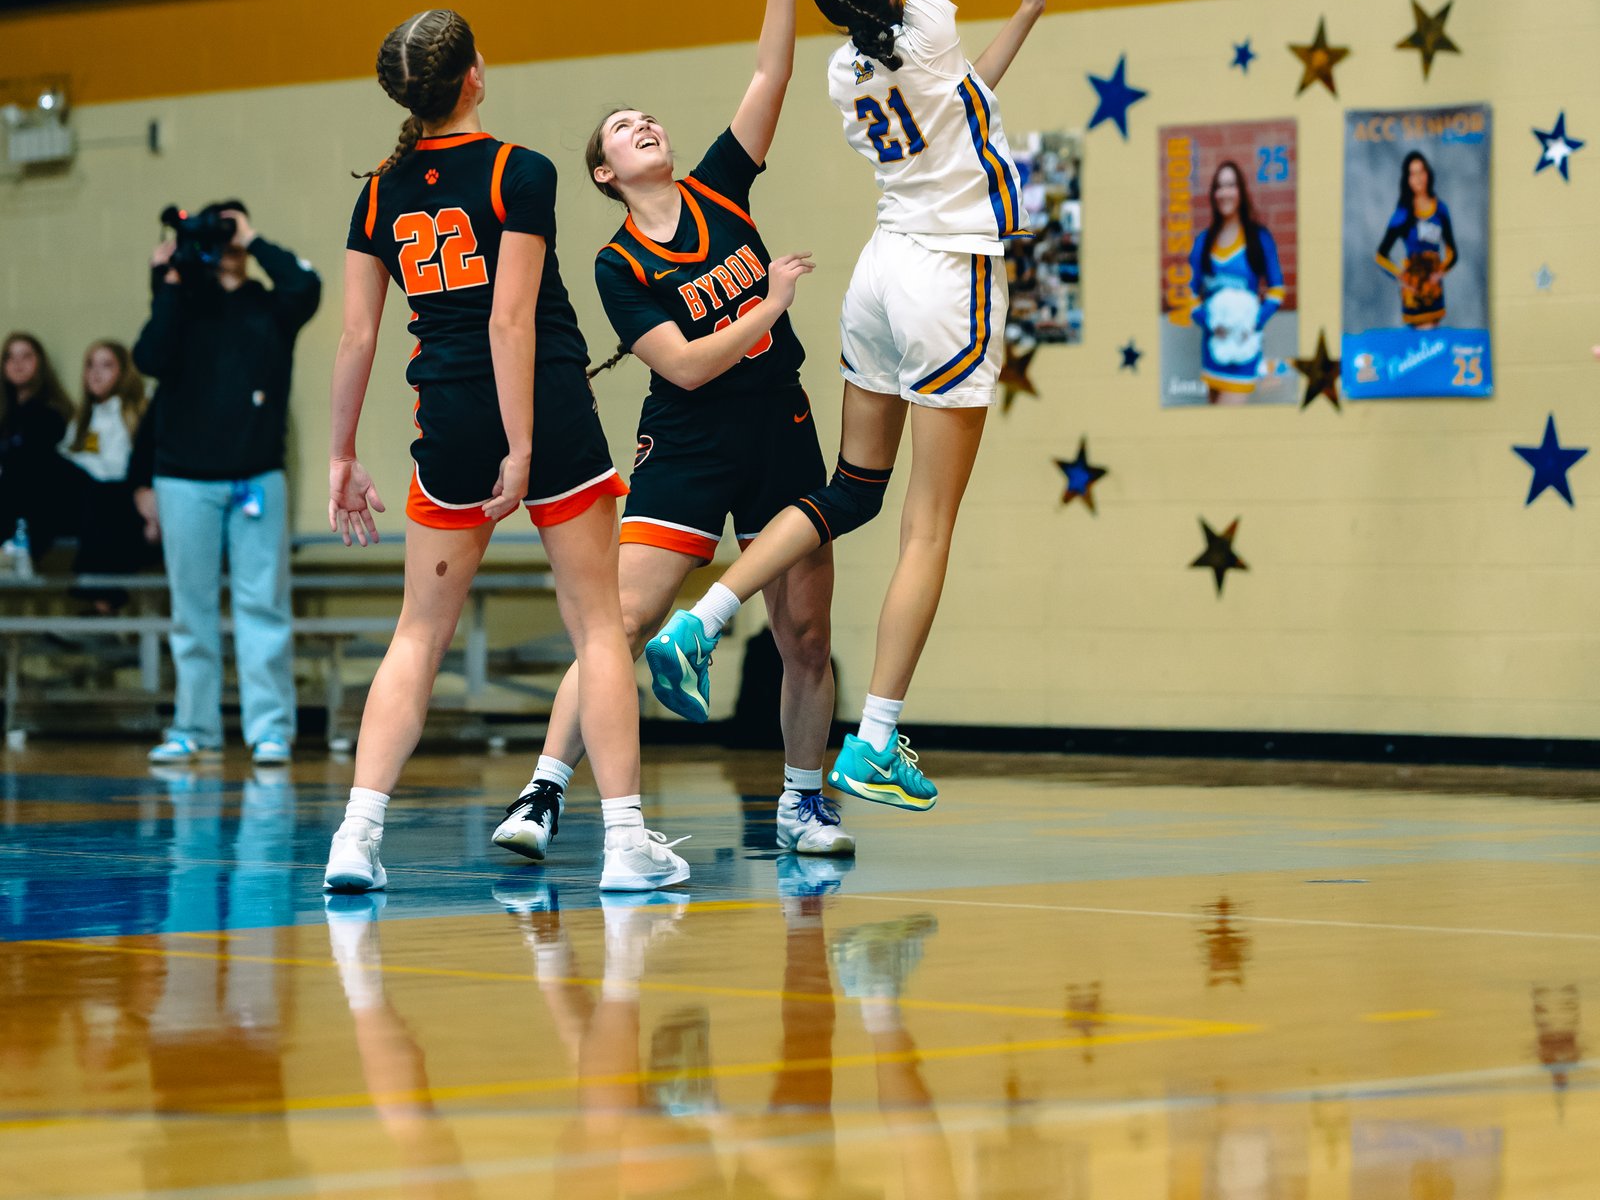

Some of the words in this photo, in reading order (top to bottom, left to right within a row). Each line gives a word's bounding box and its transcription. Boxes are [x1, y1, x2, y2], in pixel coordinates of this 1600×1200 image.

[854, 85, 928, 164] 21
[1168, 136, 1192, 254] SENIOR
[1257, 146, 1289, 183] 25
[393, 207, 489, 296] 22
[677, 244, 766, 321] BYRON
[1168, 264, 1193, 327] ACC
[1452, 357, 1483, 386] 25
